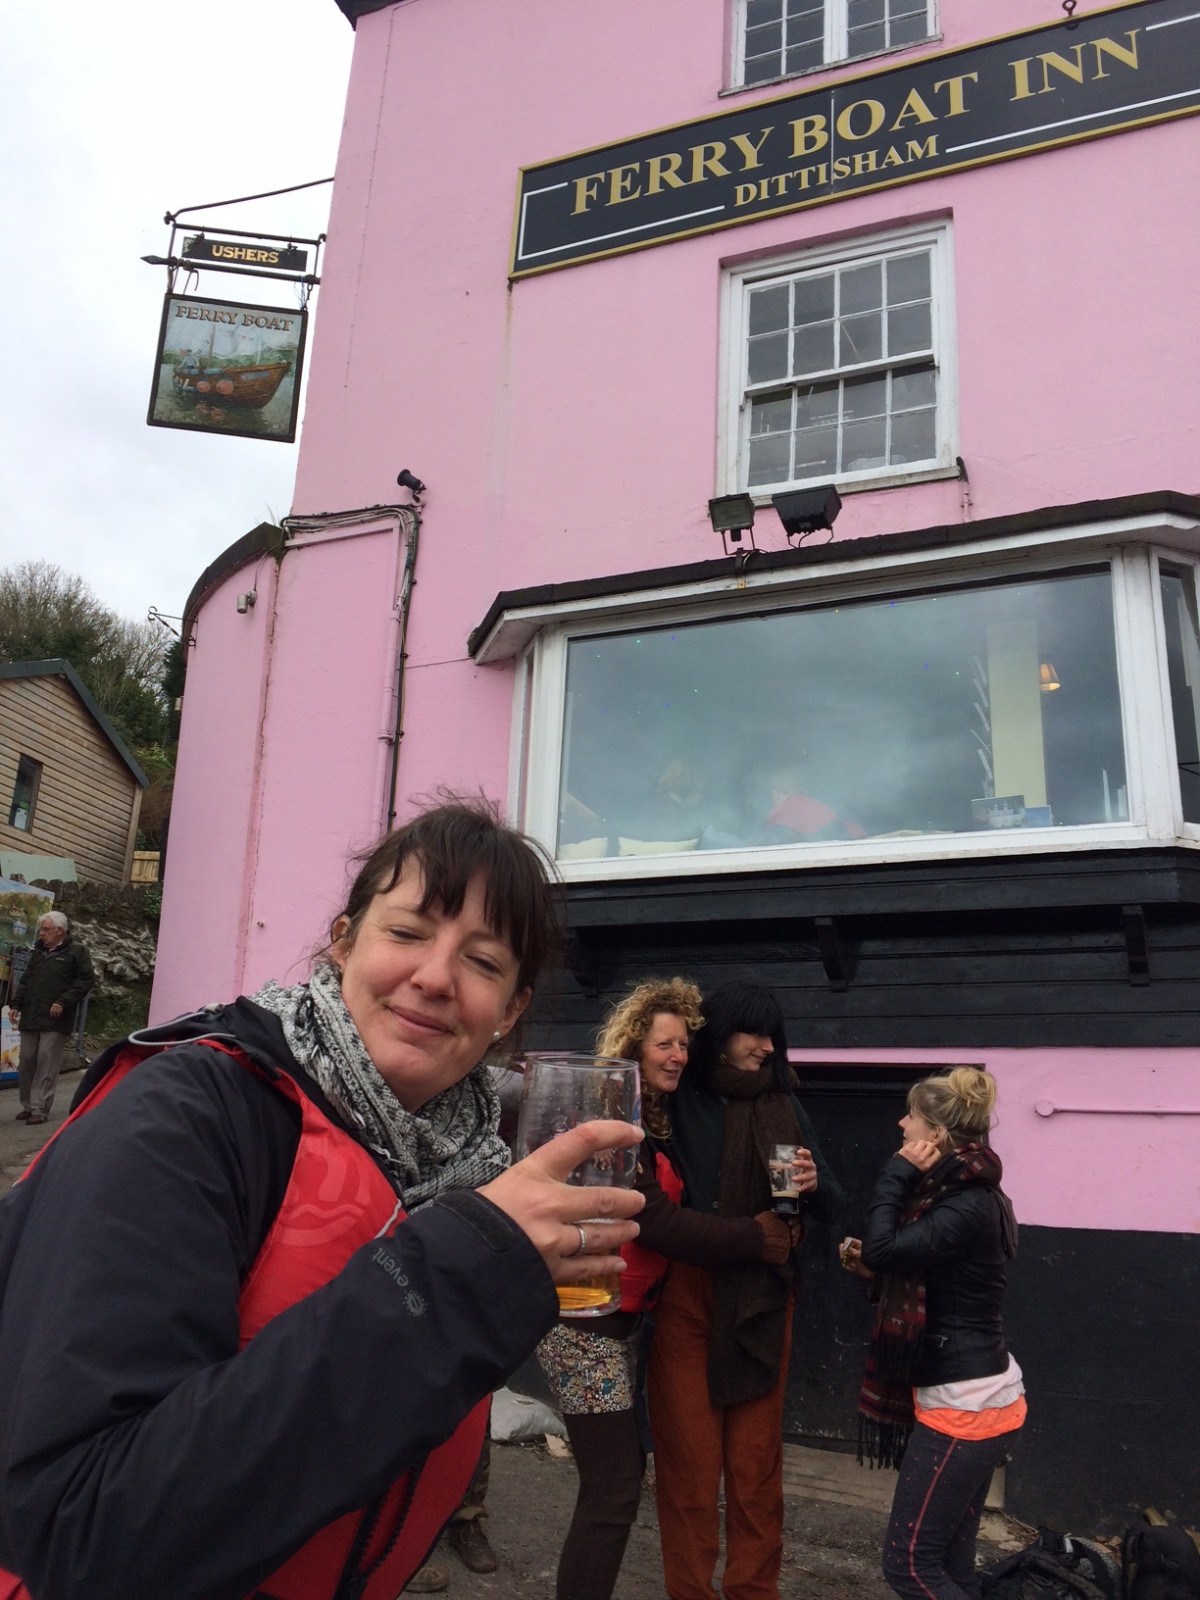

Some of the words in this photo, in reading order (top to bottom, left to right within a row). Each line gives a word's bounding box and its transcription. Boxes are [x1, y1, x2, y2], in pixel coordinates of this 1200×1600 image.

[570, 127, 774, 217] FERRY
[793, 71, 979, 159] BOAT
[1008, 29, 1141, 102] INN
[733, 135, 940, 208] DITTISHAM
[211, 245, 279, 264] USHERS
[175, 305, 238, 326] FERRY
[242, 313, 294, 332] BOAT
